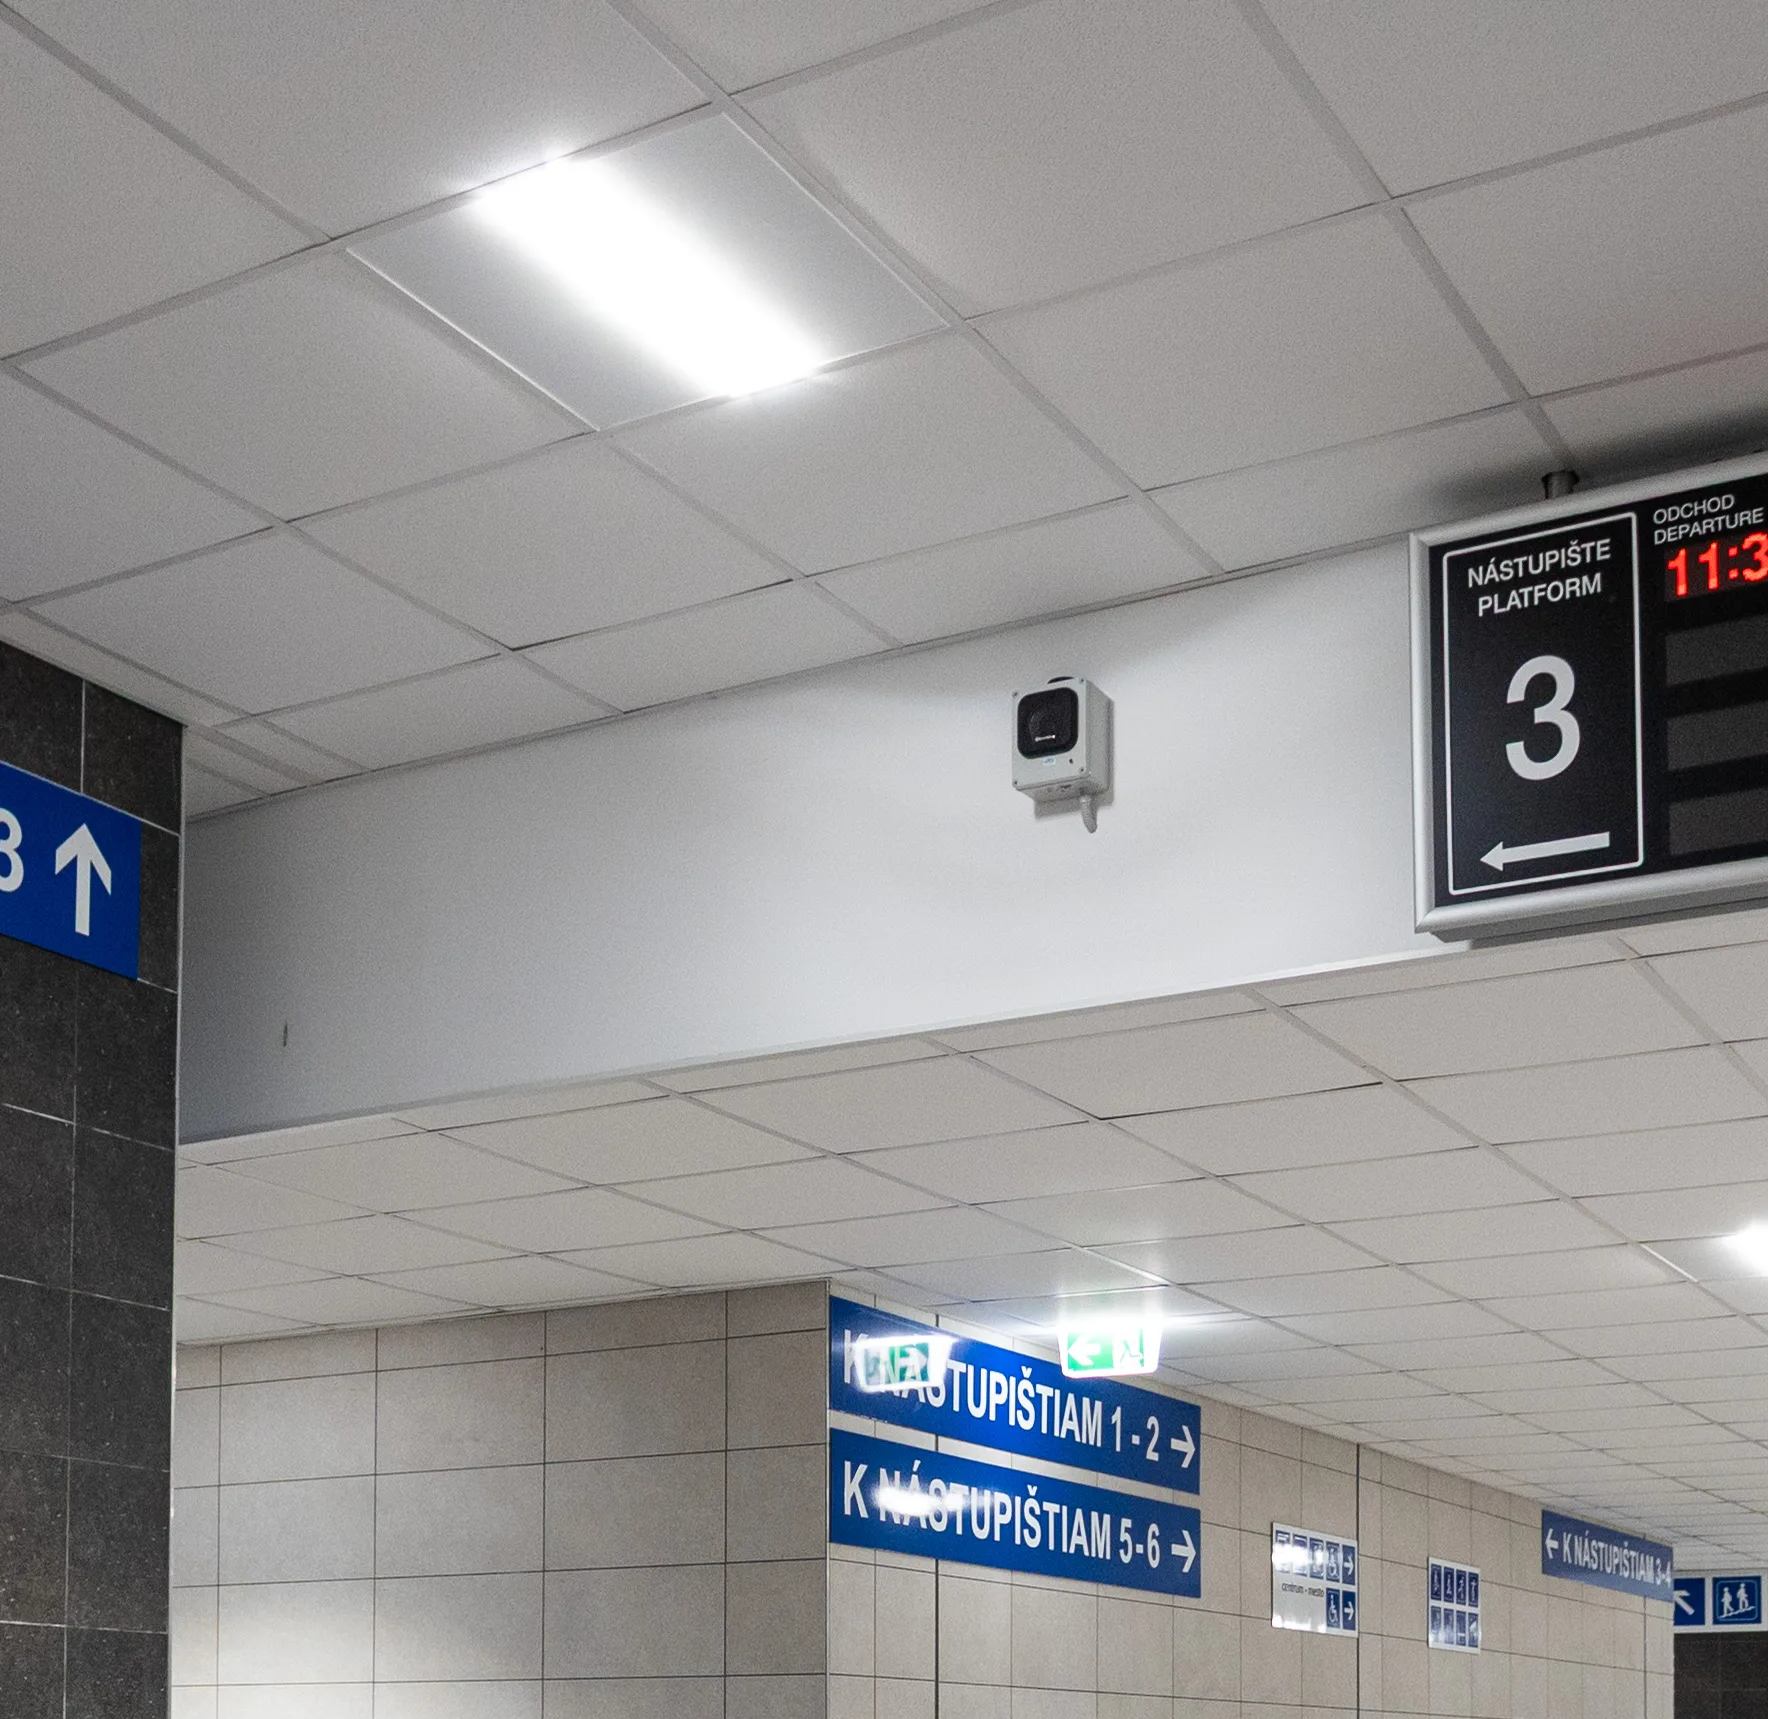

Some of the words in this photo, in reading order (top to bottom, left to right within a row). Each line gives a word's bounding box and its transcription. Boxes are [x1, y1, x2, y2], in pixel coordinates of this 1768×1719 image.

[1653, 494, 1735, 525] ODCHOD
[1654, 507, 1764, 545] DEPARTURE
[1468, 538, 1612, 588] NÁSTUPIŠTE
[1478, 572, 1602, 617] PLATFORM
[1505, 655, 1581, 781] 3
[843, 1460, 869, 1519] K
[879, 1459, 1111, 1560] NÁSTUPIŠTIAM
[1562, 1531, 1572, 1564] K
[1574, 1530, 1655, 1584] NÁSTUPIŠTIAM
